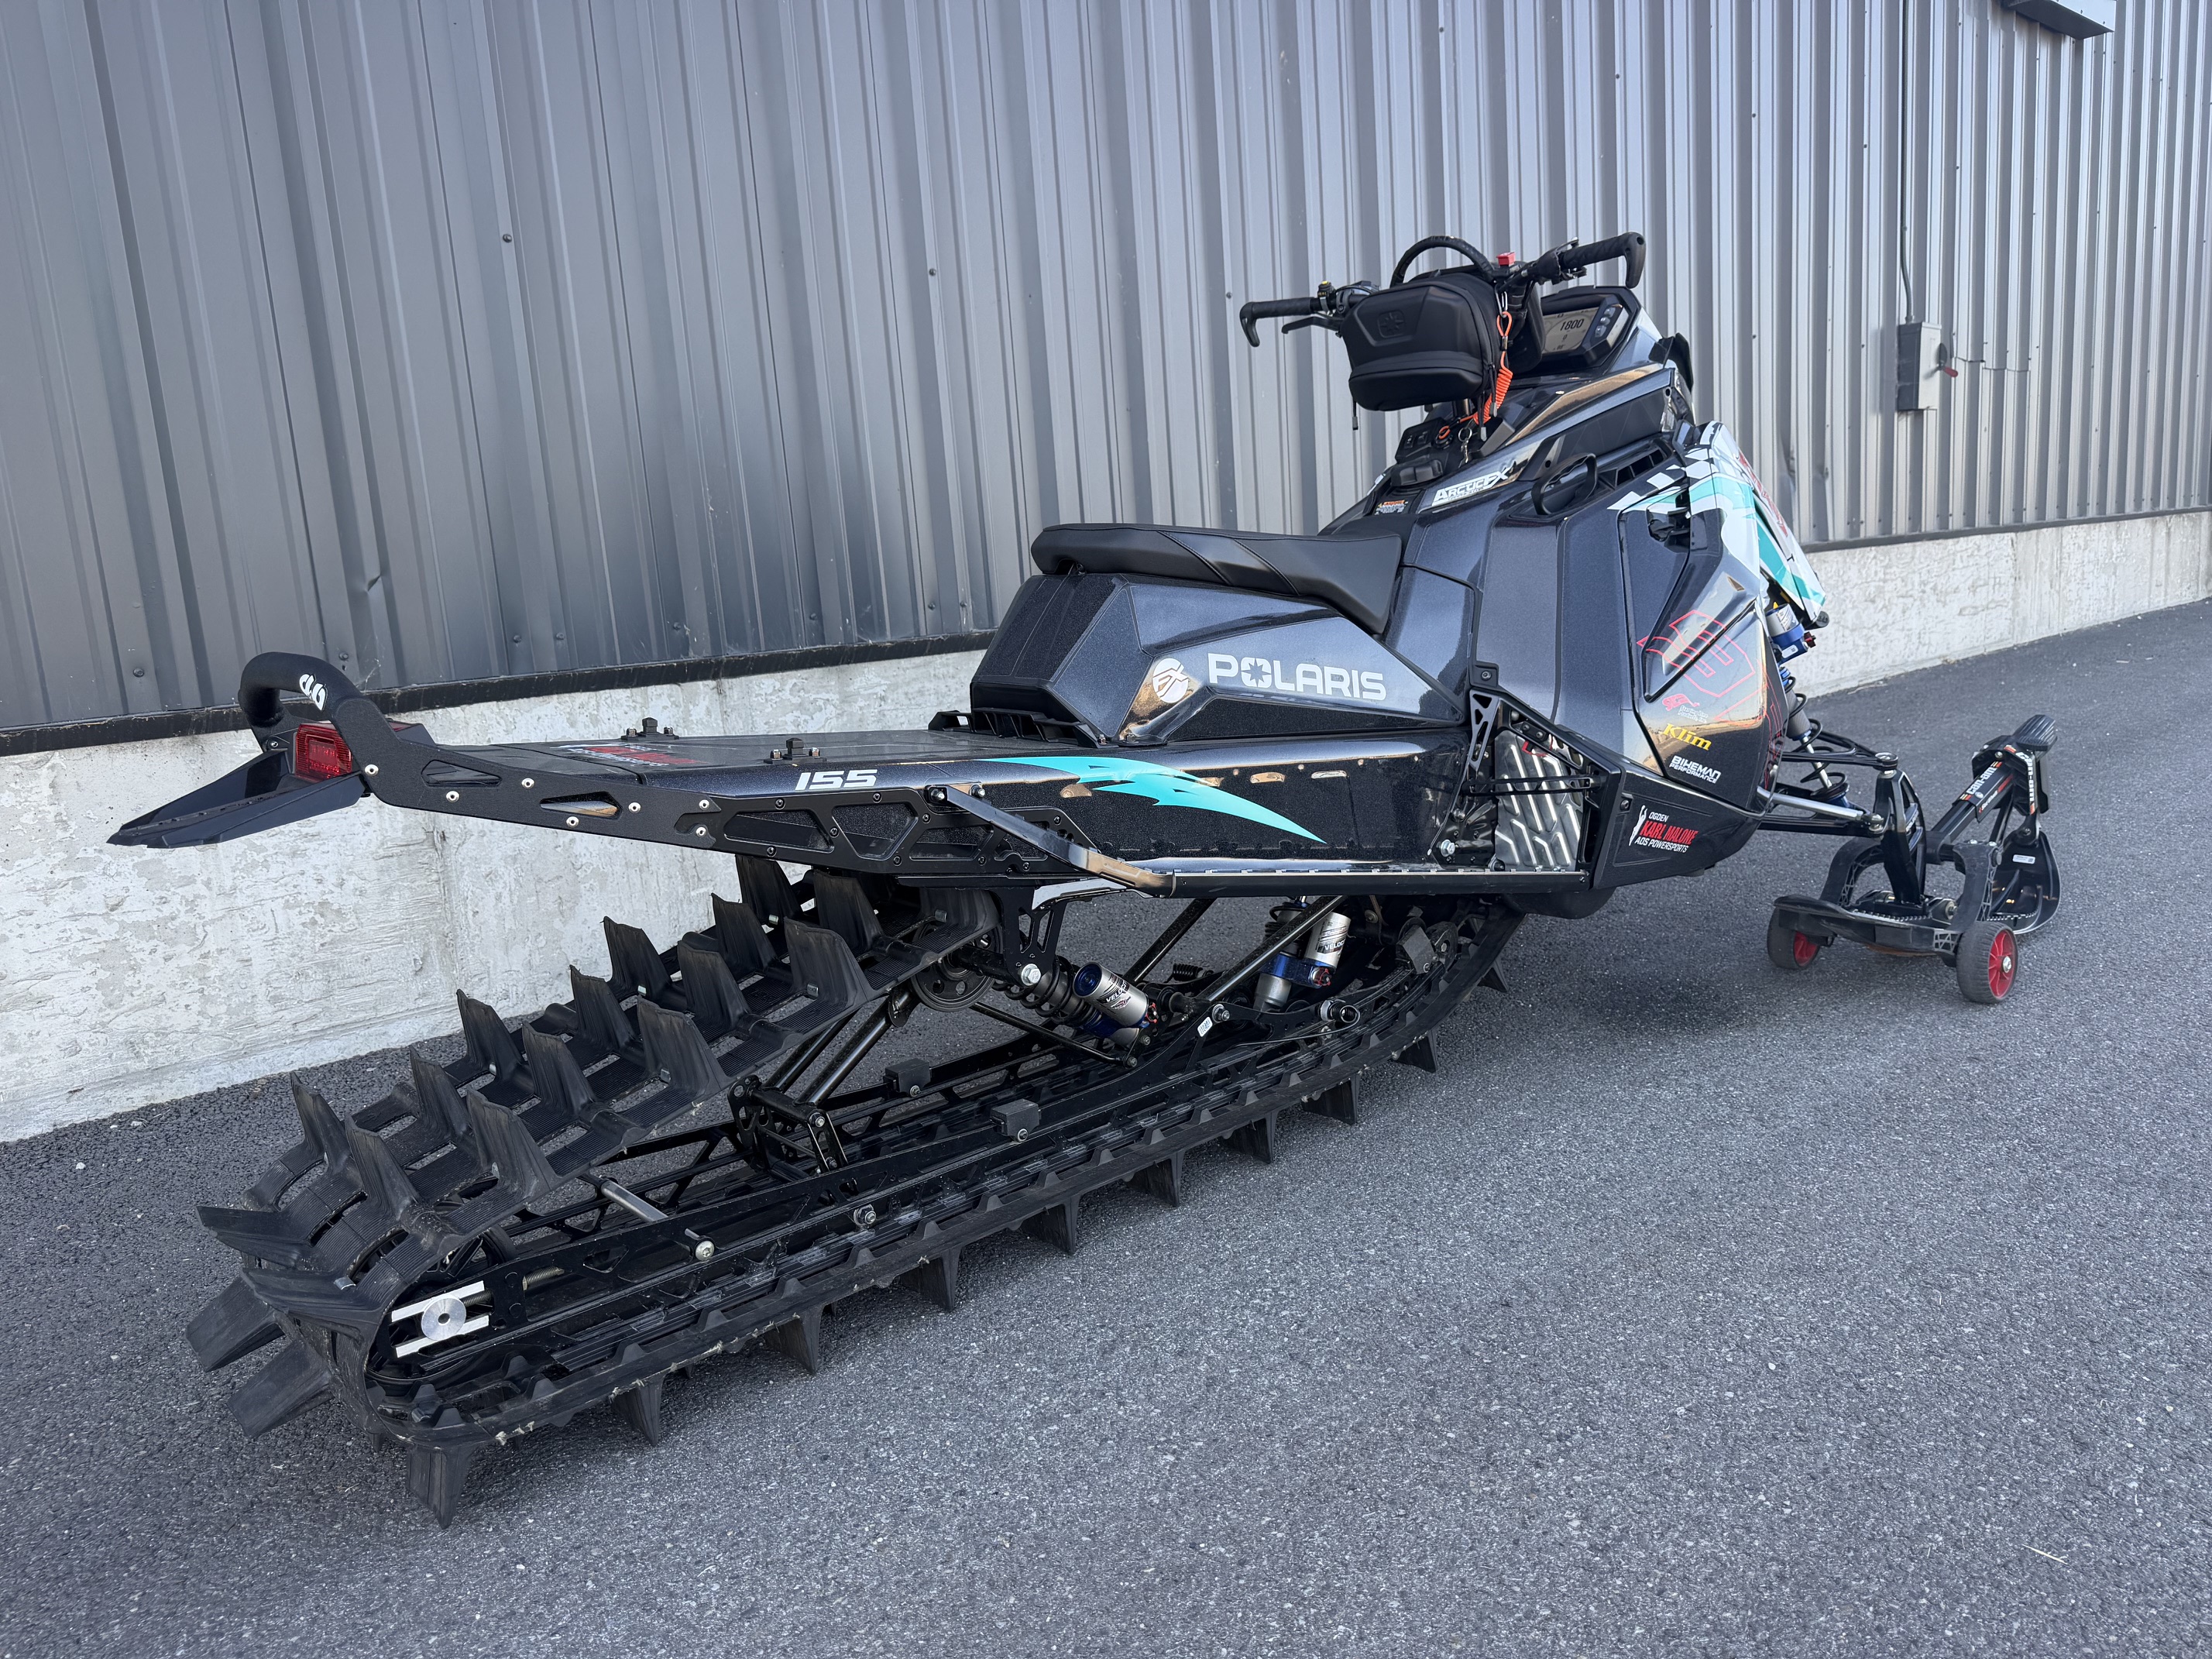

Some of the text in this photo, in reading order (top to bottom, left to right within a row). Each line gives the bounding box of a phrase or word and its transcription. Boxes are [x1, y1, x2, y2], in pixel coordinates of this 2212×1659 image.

[1560, 318, 1585, 331] 1800
[1207, 653, 1386, 701] POLARIS
[1661, 723, 1712, 751] Klim
[1669, 762, 1717, 784] PERFORMANCE
[1671, 755, 1722, 779] BIKEMAN
[795, 769, 878, 790] 155
[1966, 767, 1998, 795] can-am
[1648, 812, 1669, 823] OGDEN
[1639, 820, 1698, 845] KARL MALONE
[1648, 837, 1689, 854] POWERSPORTS
